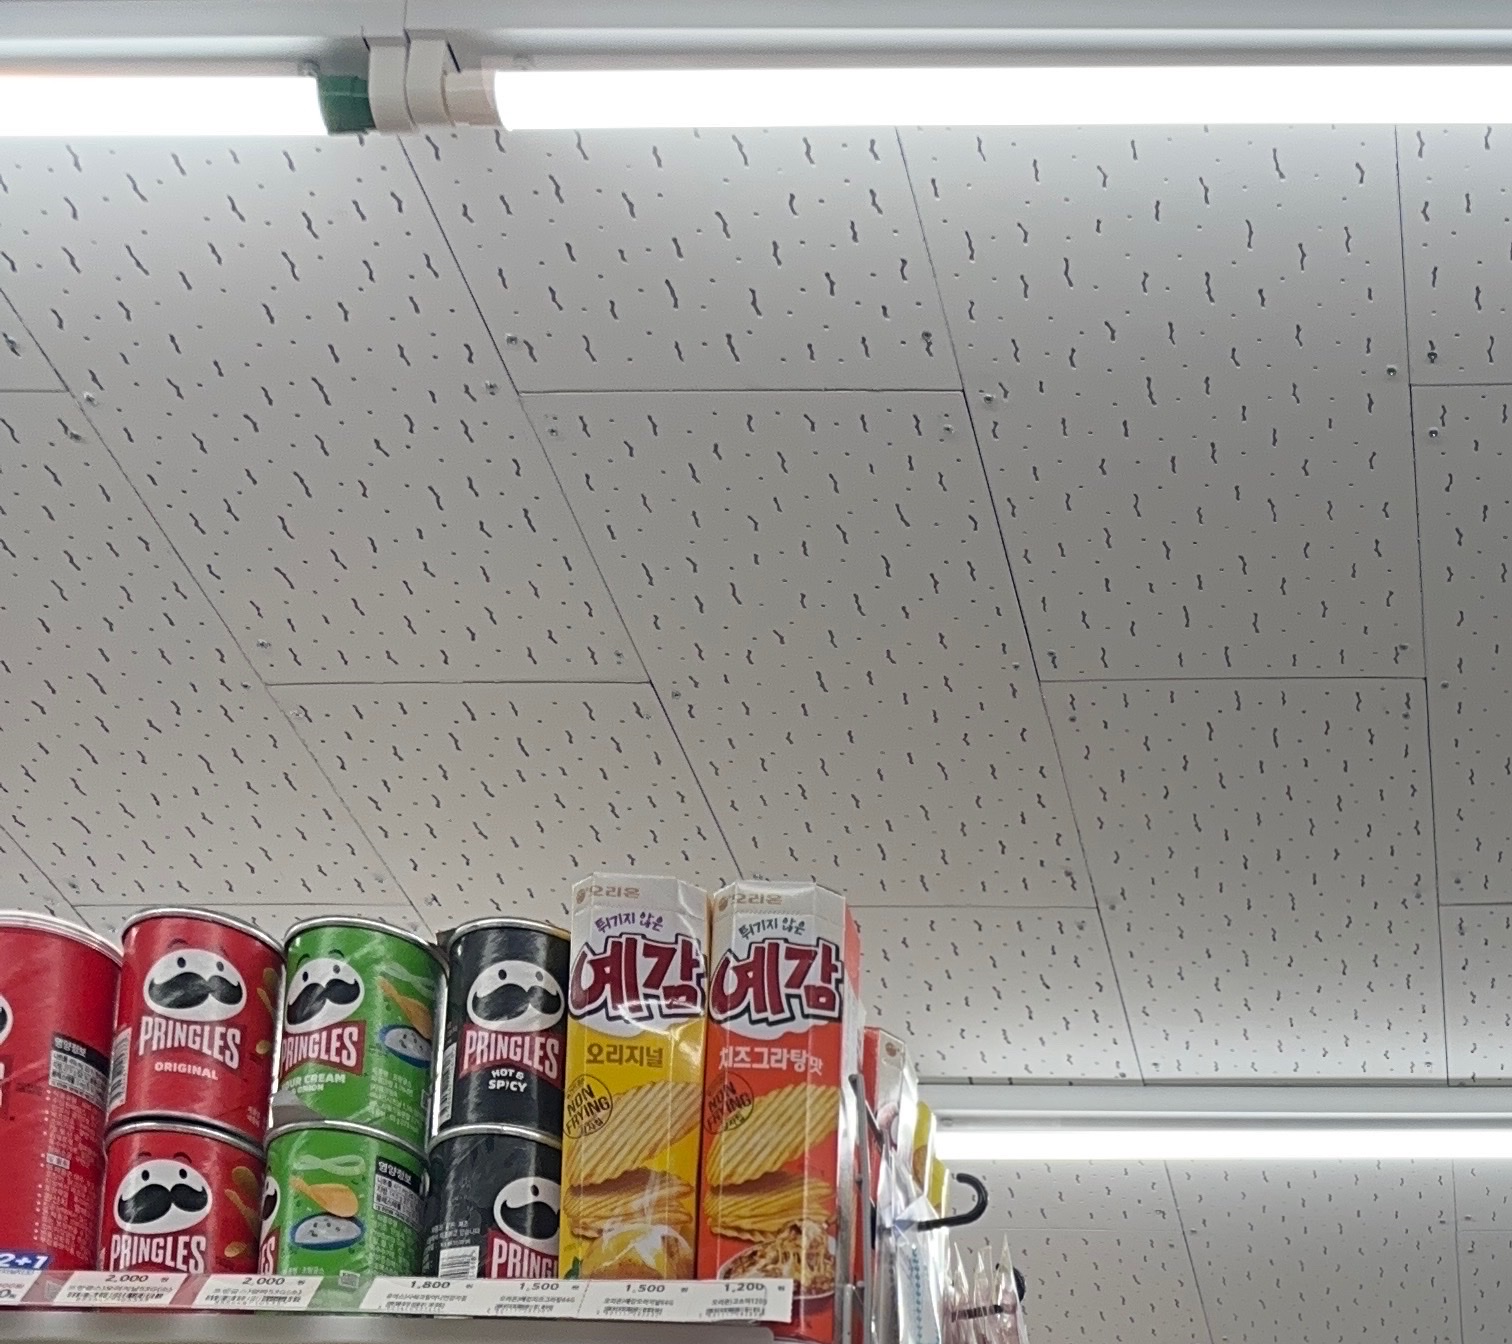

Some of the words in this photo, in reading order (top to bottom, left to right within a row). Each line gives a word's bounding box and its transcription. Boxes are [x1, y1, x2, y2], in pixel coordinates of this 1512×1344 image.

[594, 913, 637, 934] 튀기지
[639, 911, 664, 931] 않은
[738, 918, 779, 938] 튀기지
[781, 916, 807, 937] 않은
[571, 934, 706, 1018] 예감
[710, 939, 843, 1022] 예감
[139, 1016, 241, 1070] PRINGLES
[586, 1042, 664, 1069] 오리지널
[463, 1034, 560, 1080] PRINGLES
[719, 1046, 825, 1076] 치즈그라탕맛
[154, 1061, 219, 1081] ORIGINAL
[491, 1068, 513, 1079] HOT
[487, 1078, 528, 1093] SPICY
[706, 1080, 737, 1113] NON
[566, 1083, 596, 1117] NON
[705, 1094, 754, 1127] FRYING
[565, 1096, 612, 1137] FRYING
[110, 1235, 207, 1273] PRINGLES
[106, 1274, 149, 1283] 2,000
[242, 1276, 285, 1286] 2,000
[409, 1281, 451, 1290] 1,800
[519, 1283, 560, 1292] 1,500
[625, 1284, 666, 1294] 1,500
[724, 1282, 765, 1292] 1,200
